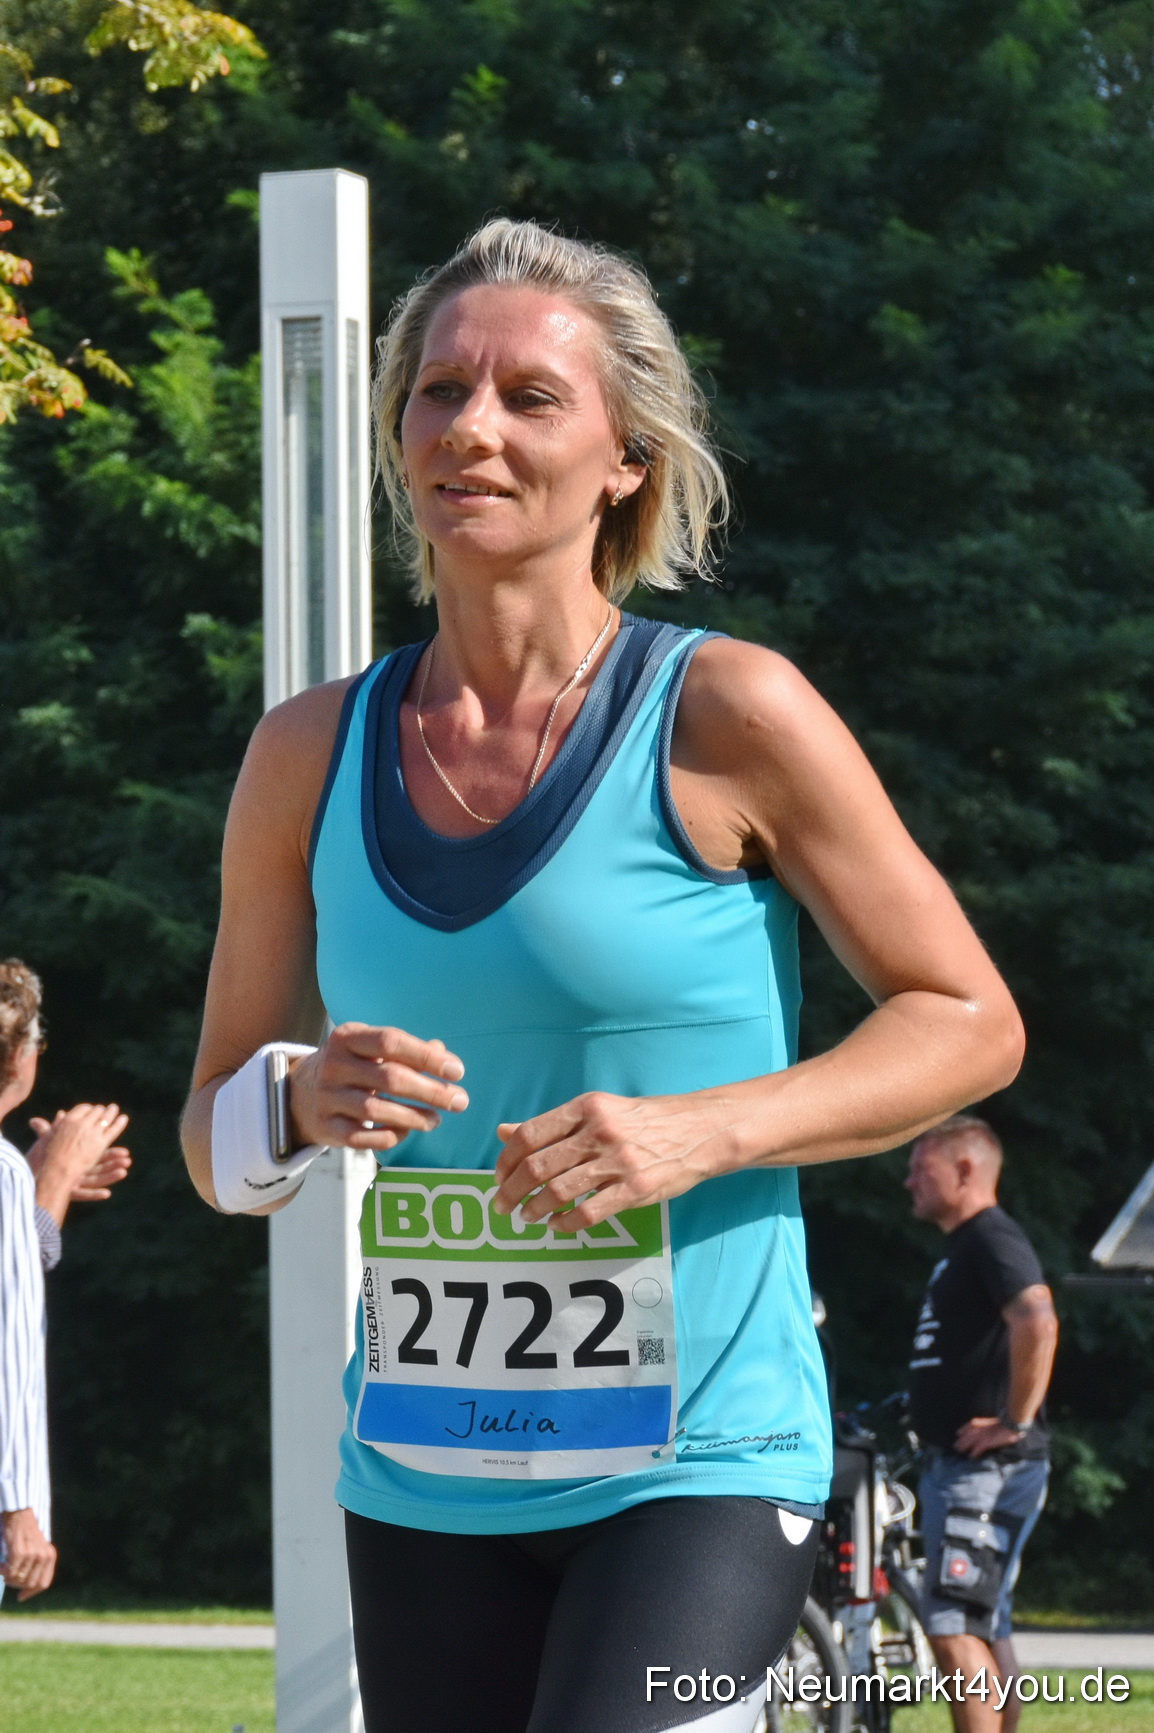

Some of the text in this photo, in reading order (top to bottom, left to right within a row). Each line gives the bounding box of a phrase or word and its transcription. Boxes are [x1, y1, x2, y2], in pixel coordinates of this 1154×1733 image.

[375, 1266, 383, 1317] ZEITMESSUNG
[391, 1278, 630, 1369] 2722
[444, 1401, 561, 1439] Julia
[773, 1443, 799, 1451] PLUS
